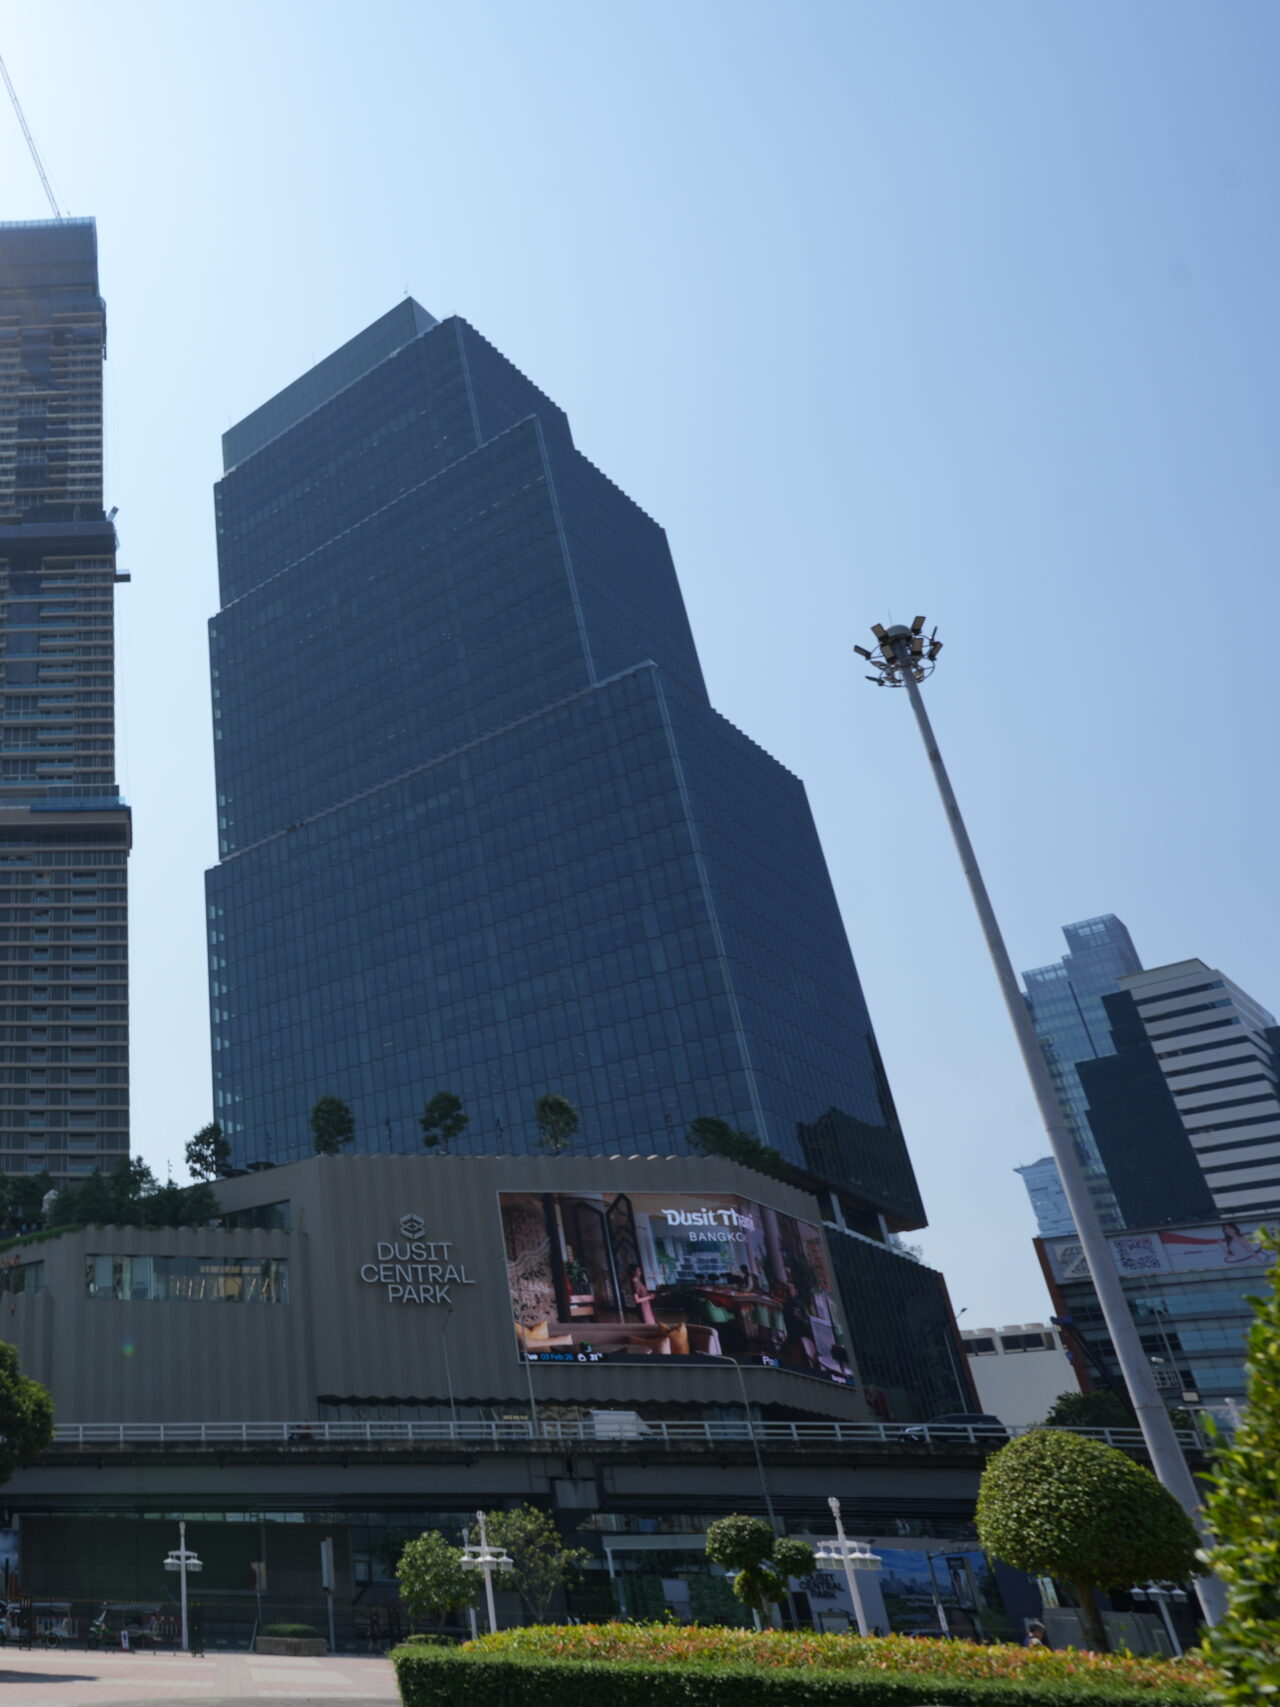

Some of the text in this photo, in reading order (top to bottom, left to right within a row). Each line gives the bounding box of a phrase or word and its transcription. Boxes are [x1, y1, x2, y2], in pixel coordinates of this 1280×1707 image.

[661, 1207, 716, 1226] Dusit
[688, 1231, 746, 1243] BANGKO
[376, 1241, 454, 1261] DUSIT
[360, 1263, 476, 1284] CENTRAL
[387, 1284, 453, 1304] PARK
